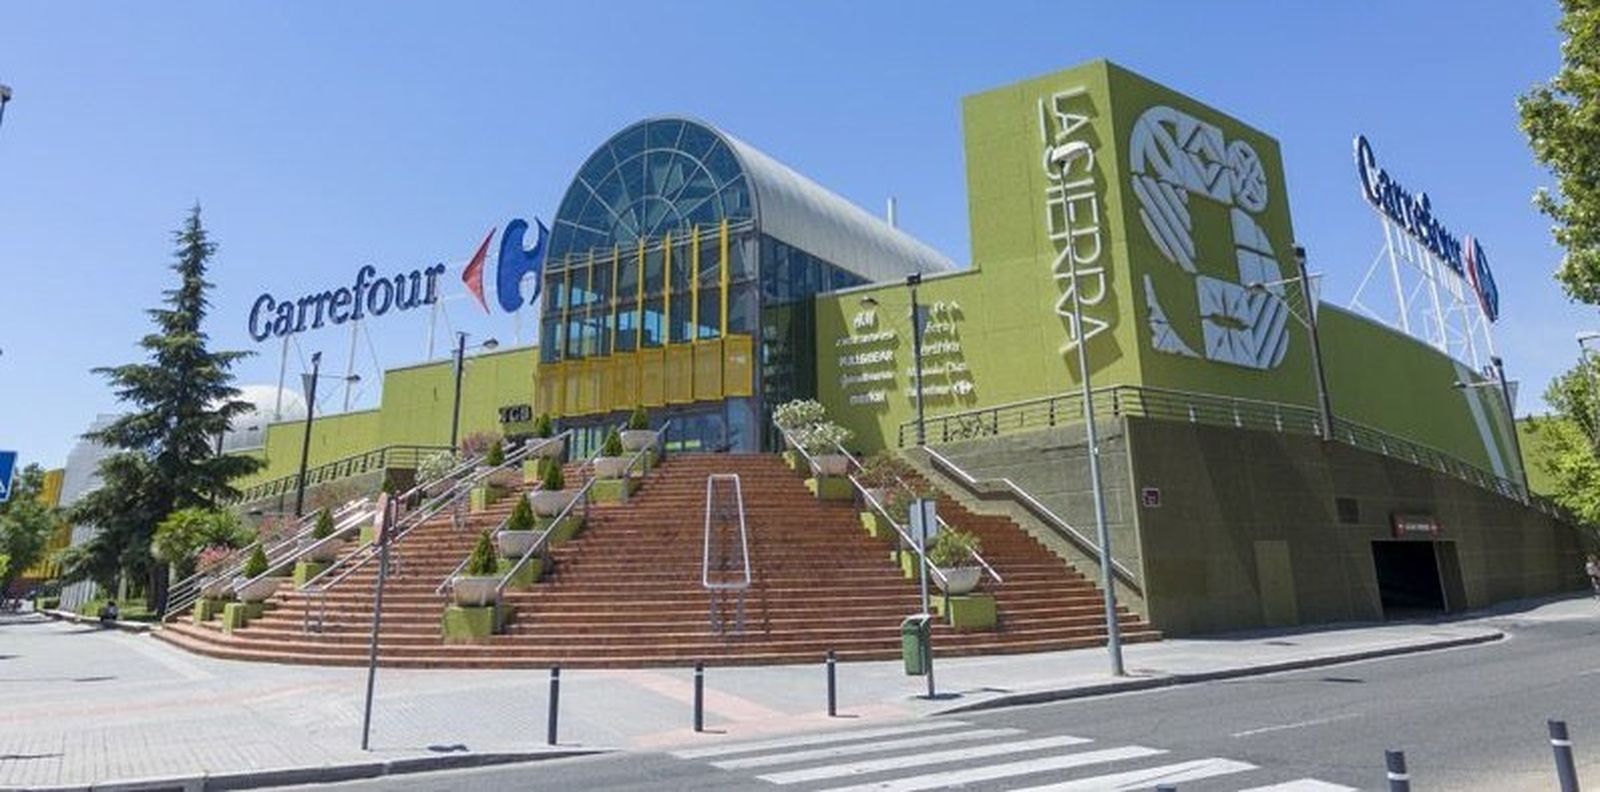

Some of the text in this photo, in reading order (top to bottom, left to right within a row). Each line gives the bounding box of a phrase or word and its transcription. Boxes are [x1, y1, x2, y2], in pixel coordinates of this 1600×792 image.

[1054, 86, 1090, 140] LA
[1354, 136, 1465, 279] Carrefour
[248, 263, 446, 342] Carrefour
